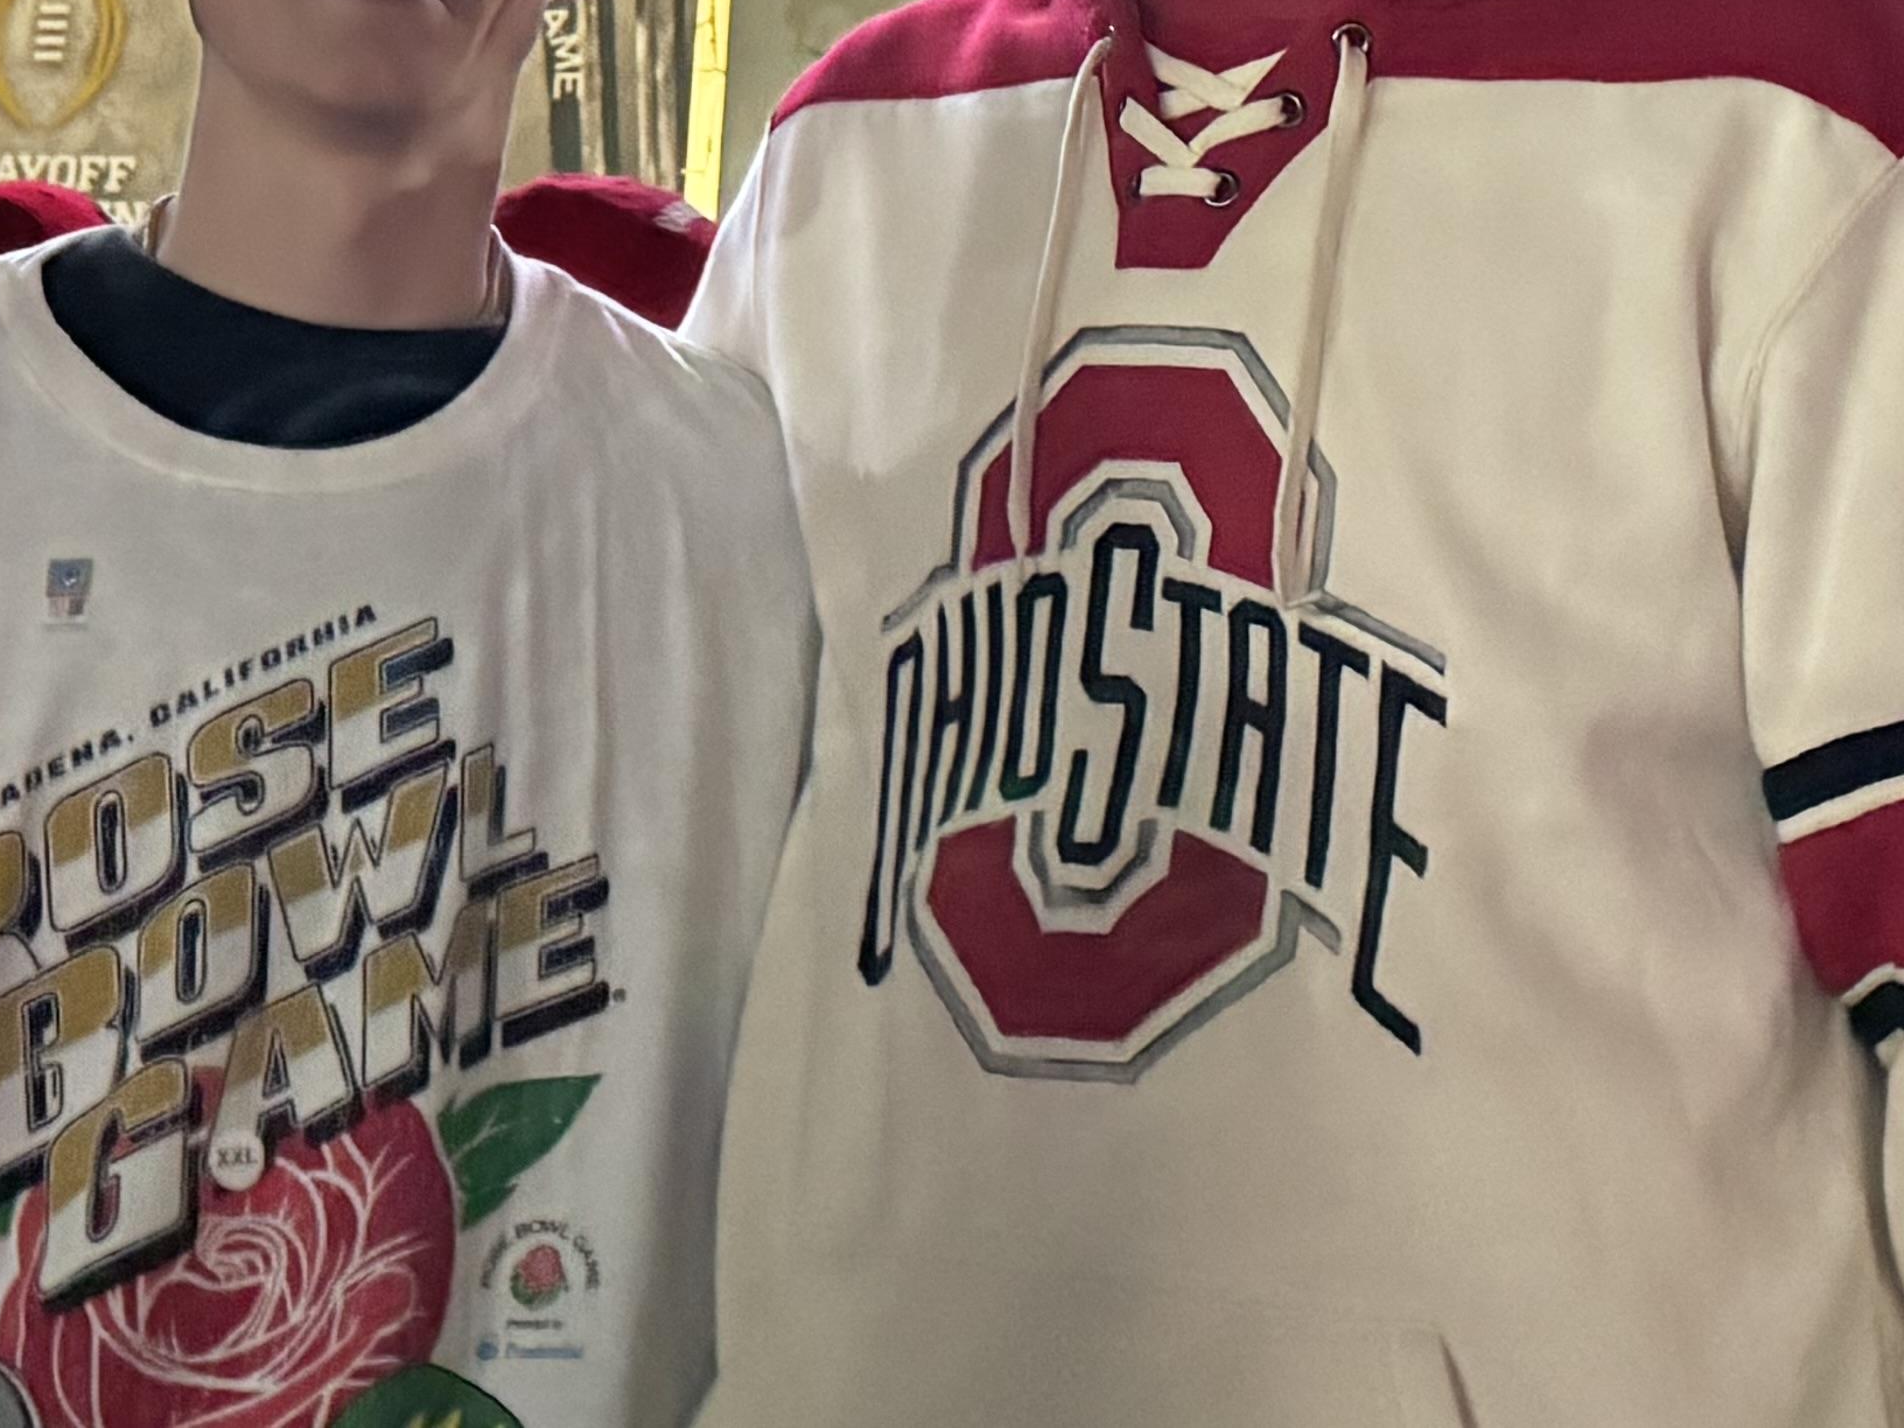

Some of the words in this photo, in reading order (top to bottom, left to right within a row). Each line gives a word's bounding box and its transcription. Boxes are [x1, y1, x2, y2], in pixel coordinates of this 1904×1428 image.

[149, 604, 377, 728] CALIFORNIA
[858, 572, 1069, 986] OHIO
[1057, 522, 1448, 1056] STATE
[38, 853, 608, 1309] GAME
